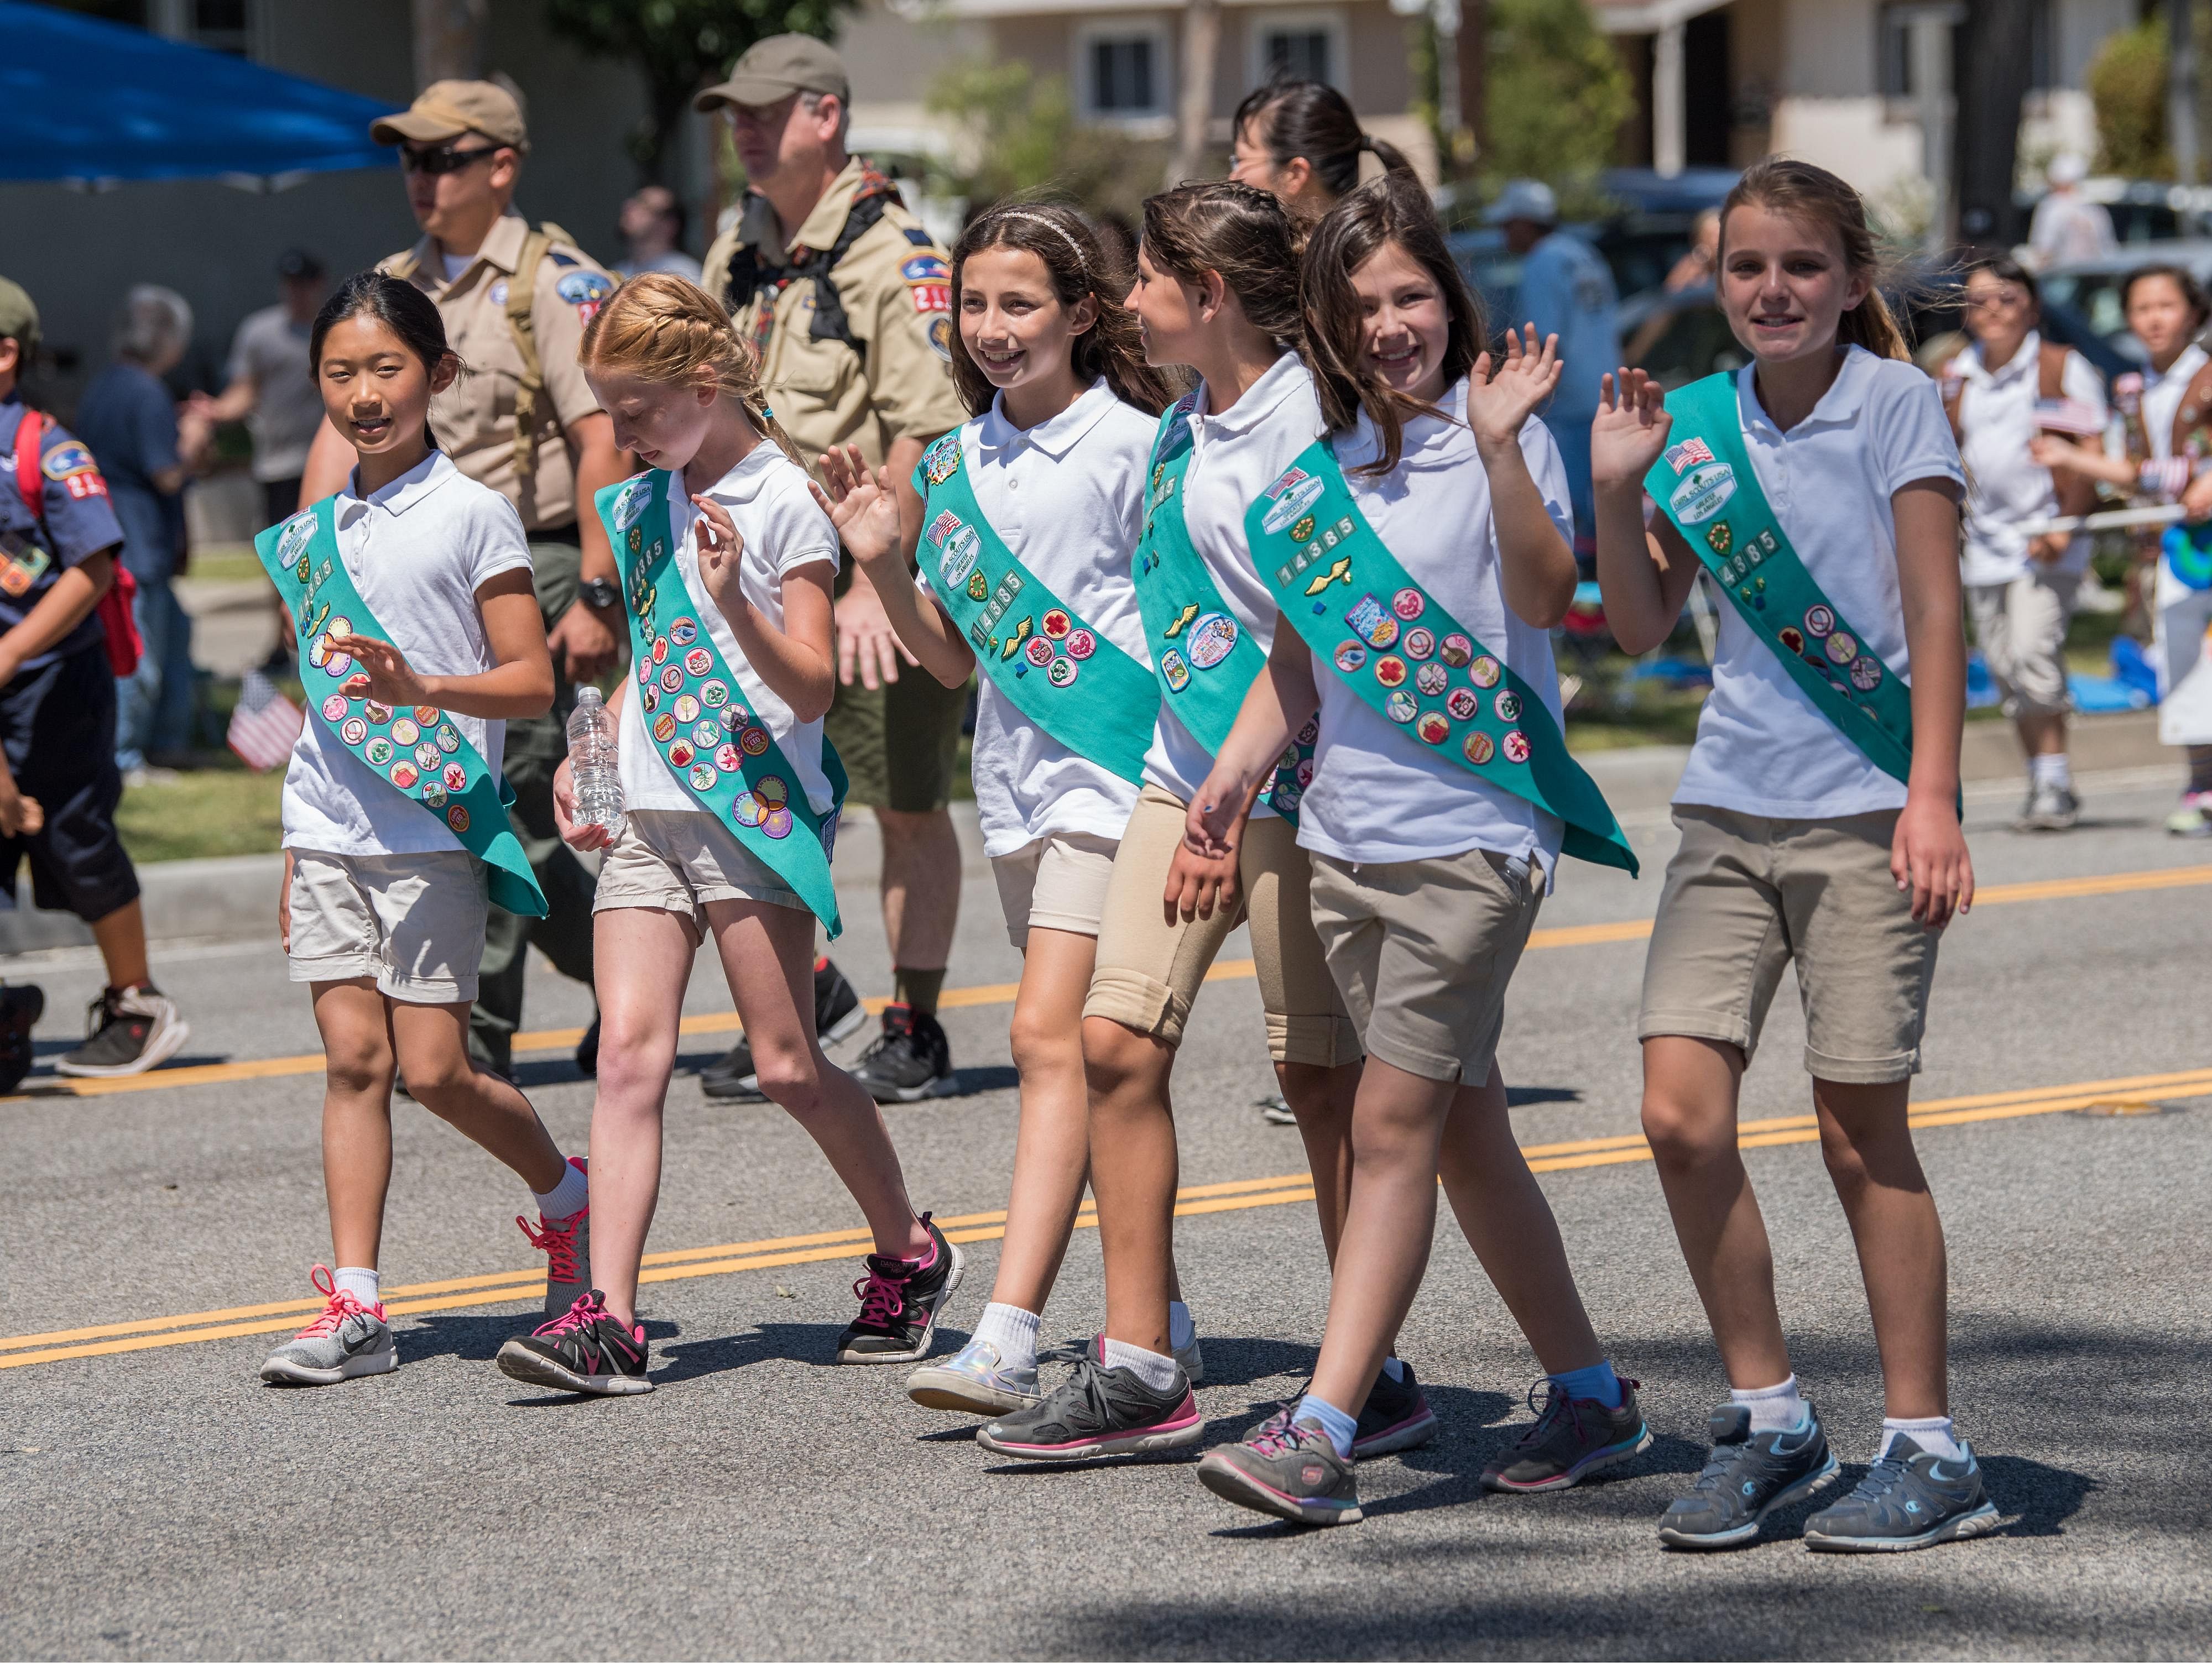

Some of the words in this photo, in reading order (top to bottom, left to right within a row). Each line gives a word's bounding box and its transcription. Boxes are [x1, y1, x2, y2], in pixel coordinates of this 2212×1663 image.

[935, 439, 958, 457] THINKING
[1688, 477, 1714, 496] SCOUTS
[1714, 469, 1729, 480] USA
[621, 491, 639, 508] SCOUTS
[1279, 491, 1305, 513] SCOUTS
[1695, 493, 1717, 510] GREATER
[1693, 511, 1704, 520] LOS
[286, 526, 304, 545] SCOUTS
[942, 562, 950, 574] GIRL
[949, 540, 965, 562] SCOUTS
[963, 530, 973, 542] USA
[1281, 519, 1352, 581] 14385
[630, 541, 661, 590] 14385
[955, 553, 968, 572] GREATER
[961, 554, 974, 574] ANGELES
[974, 573, 1019, 639] 14385
[744, 731, 760, 742] Cookie
[750, 737, 760, 745] CEO
